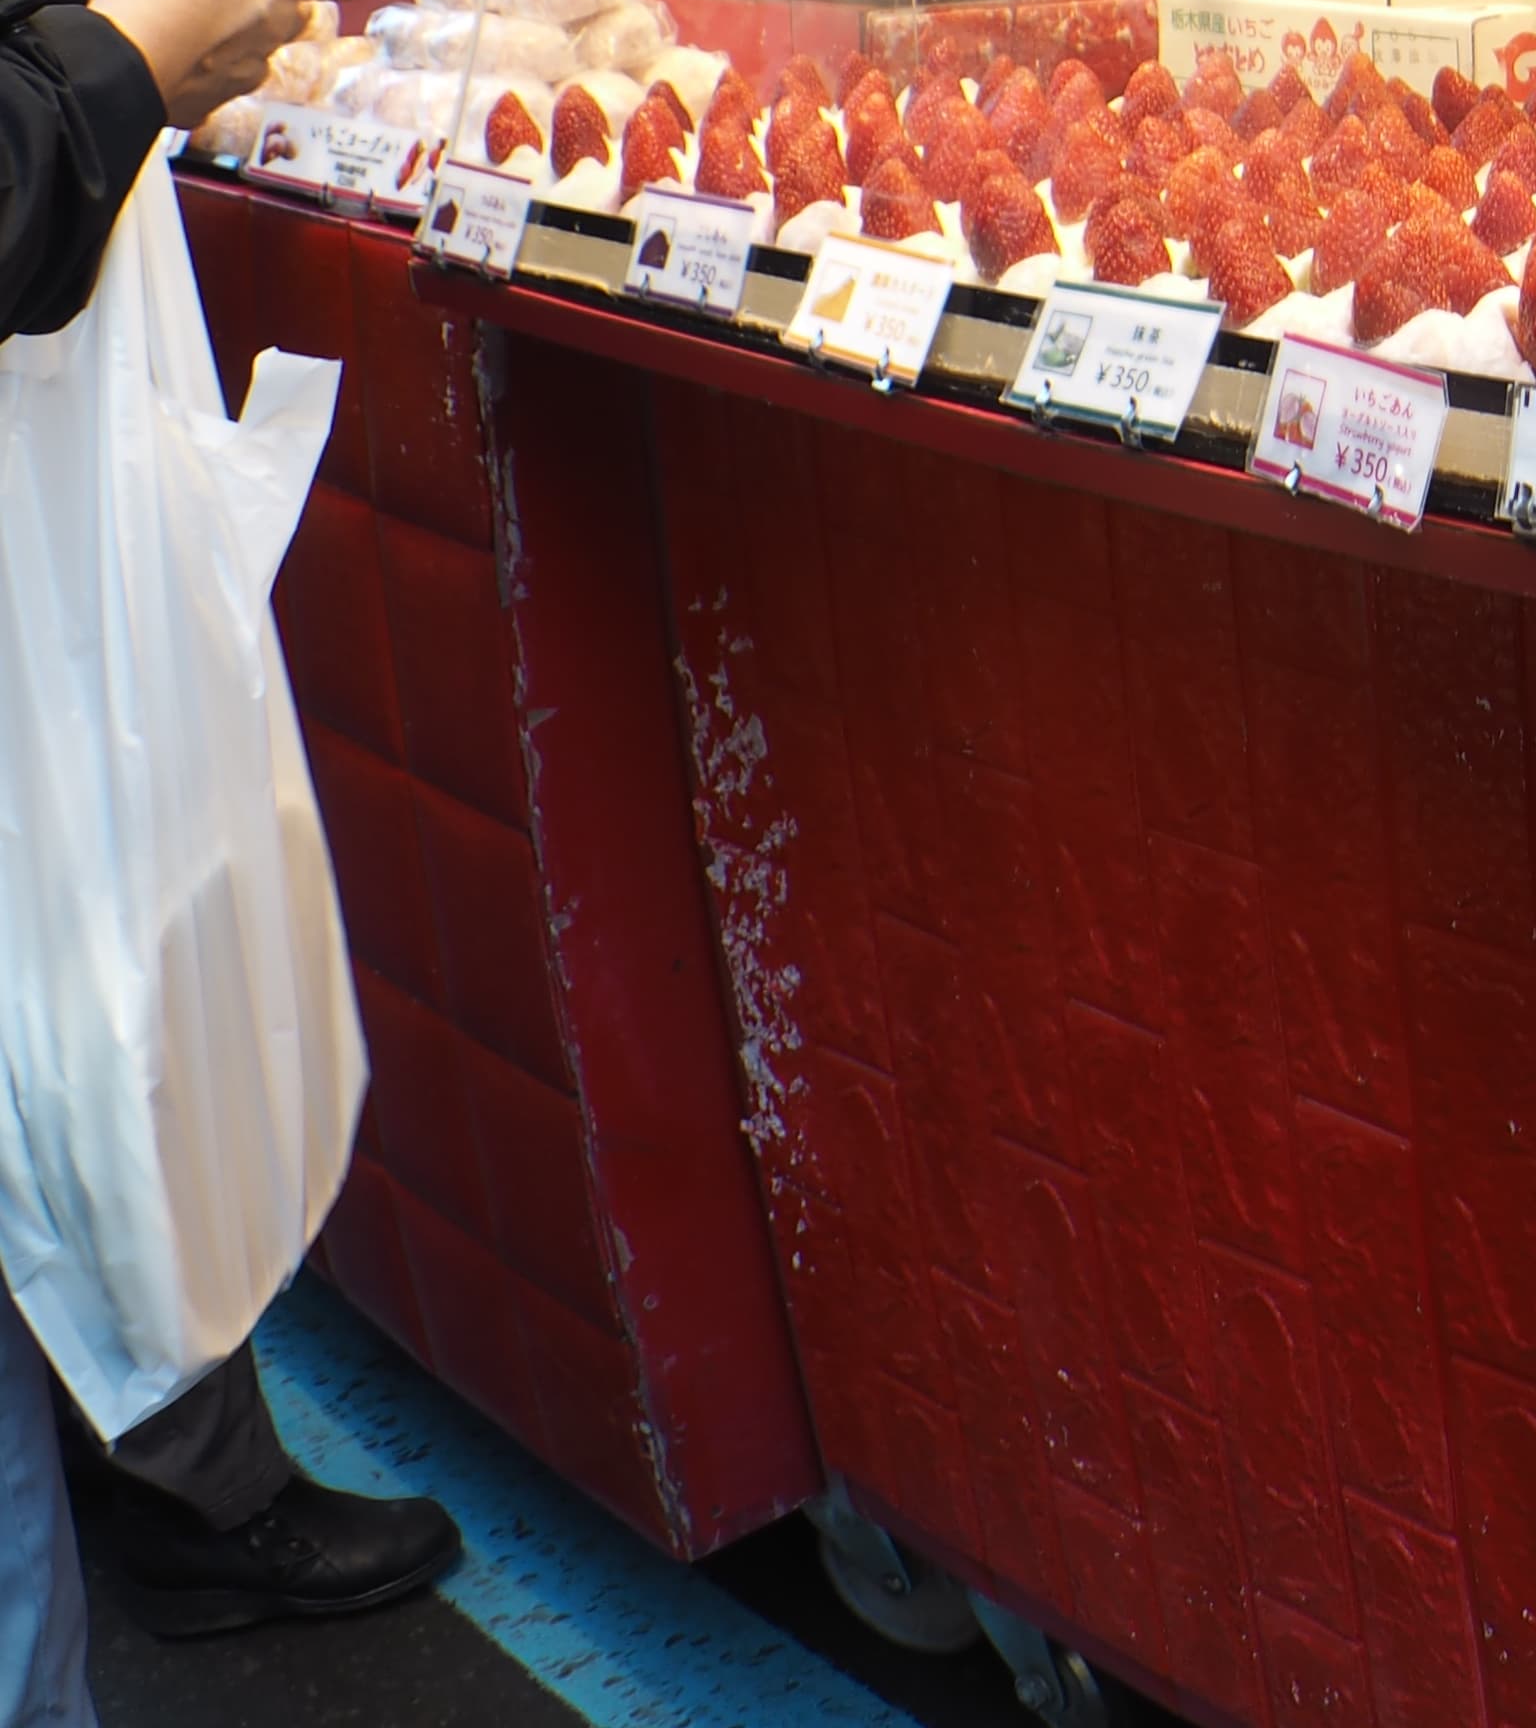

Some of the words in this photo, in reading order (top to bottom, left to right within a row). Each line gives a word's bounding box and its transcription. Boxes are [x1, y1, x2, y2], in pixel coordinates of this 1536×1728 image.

[680, 257, 717, 286] ¥350
[863, 312, 907, 341] ¥350
[1094, 360, 1152, 393] ¥350
[1354, 386, 1415, 420] いちごあん
[1335, 442, 1388, 483] ¥350
